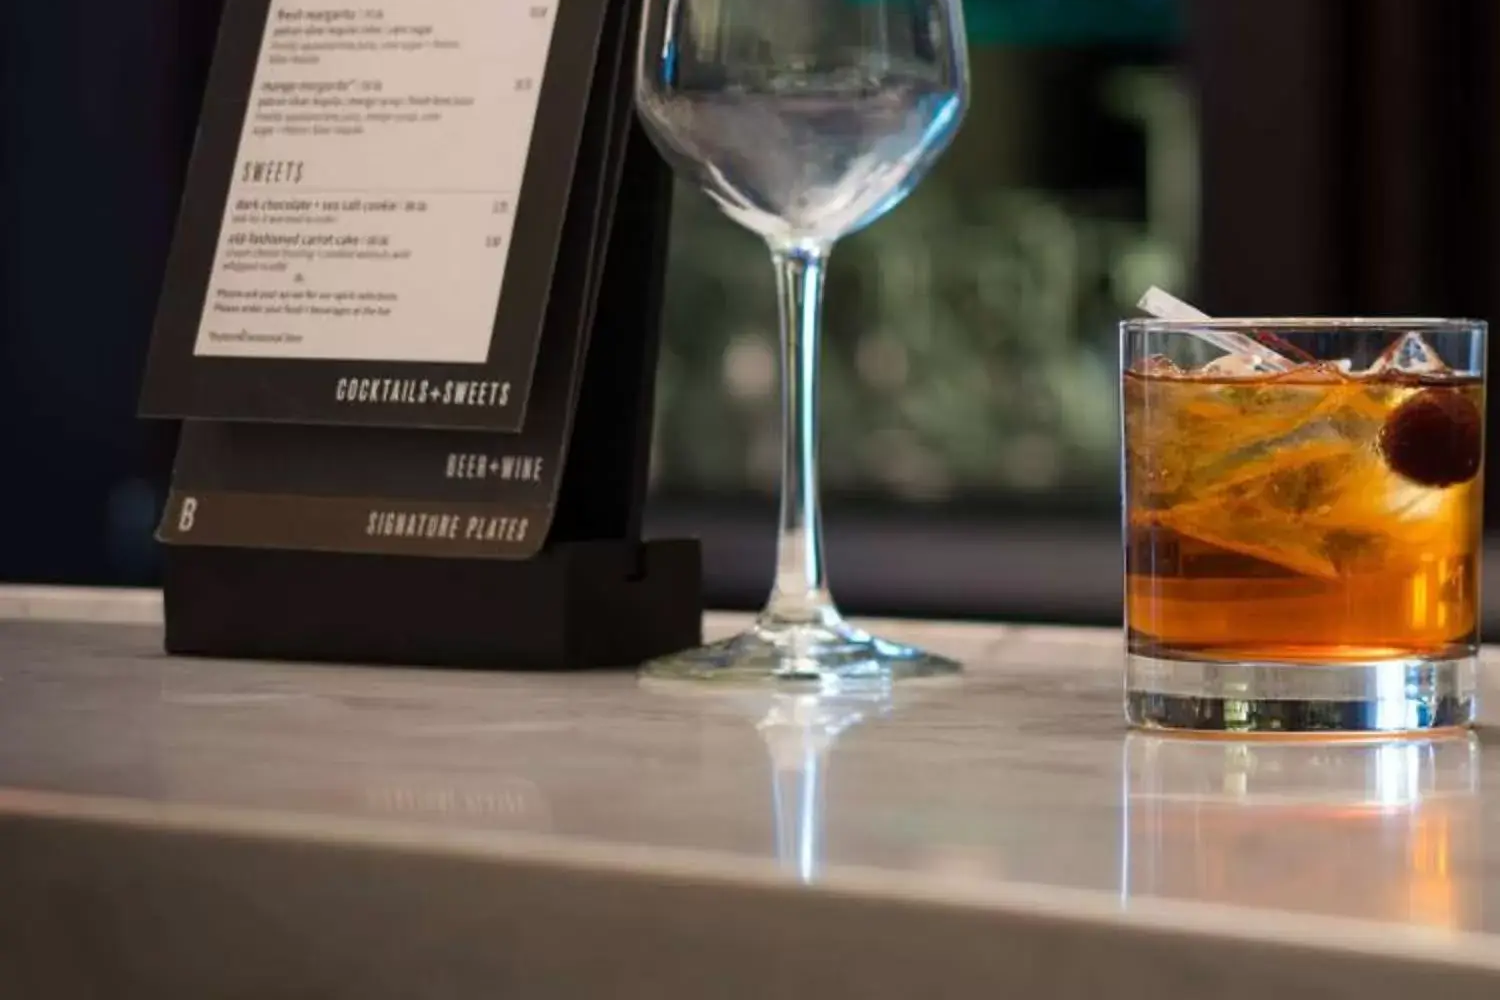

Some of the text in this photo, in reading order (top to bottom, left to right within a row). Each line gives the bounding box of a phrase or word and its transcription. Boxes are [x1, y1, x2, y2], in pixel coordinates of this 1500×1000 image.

[242, 160, 304, 184] SWEETS
[335, 377, 512, 408] COCKTAILS+SWEETS
[445, 453, 544, 482] BEER+WINE
[178, 497, 199, 532] B
[366, 511, 530, 542] SIGNATURE PLATES
